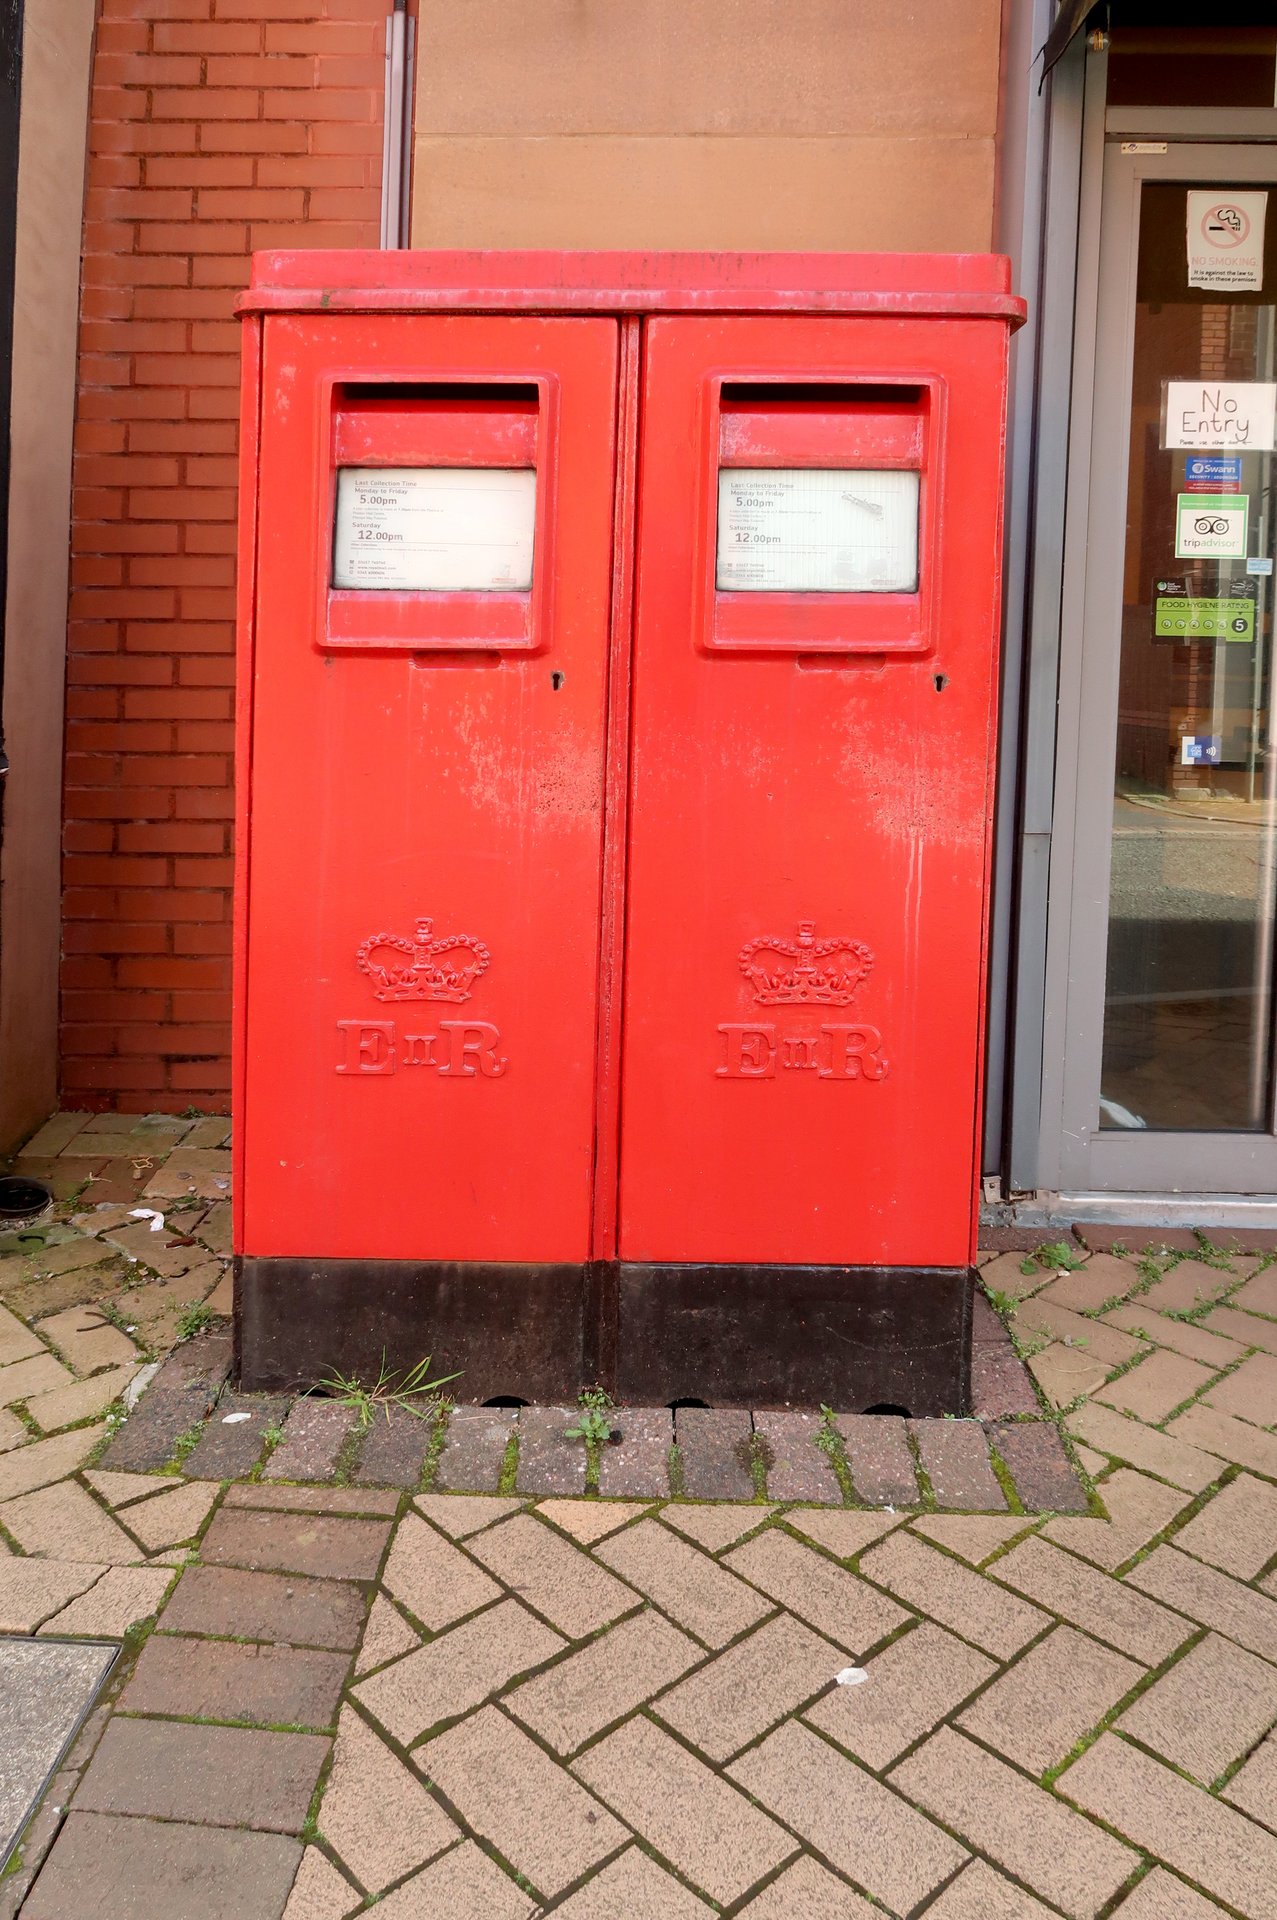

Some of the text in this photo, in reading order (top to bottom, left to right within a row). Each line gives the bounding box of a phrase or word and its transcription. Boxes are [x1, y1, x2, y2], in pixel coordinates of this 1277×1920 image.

[1192, 257, 1206, 265] NO
[1203, 389, 1237, 412] No
[1183, 412, 1249, 441] Entry
[1205, 465, 1235, 473] Swann
[360, 495, 397, 505] 5.00pm
[736, 497, 773, 508] 5.00pm
[358, 530, 403, 541] 12.00pm
[735, 533, 780, 543] 12.00pm
[1184, 538, 1235, 548] tripadvisor
[1235, 620, 1244, 631] 5
